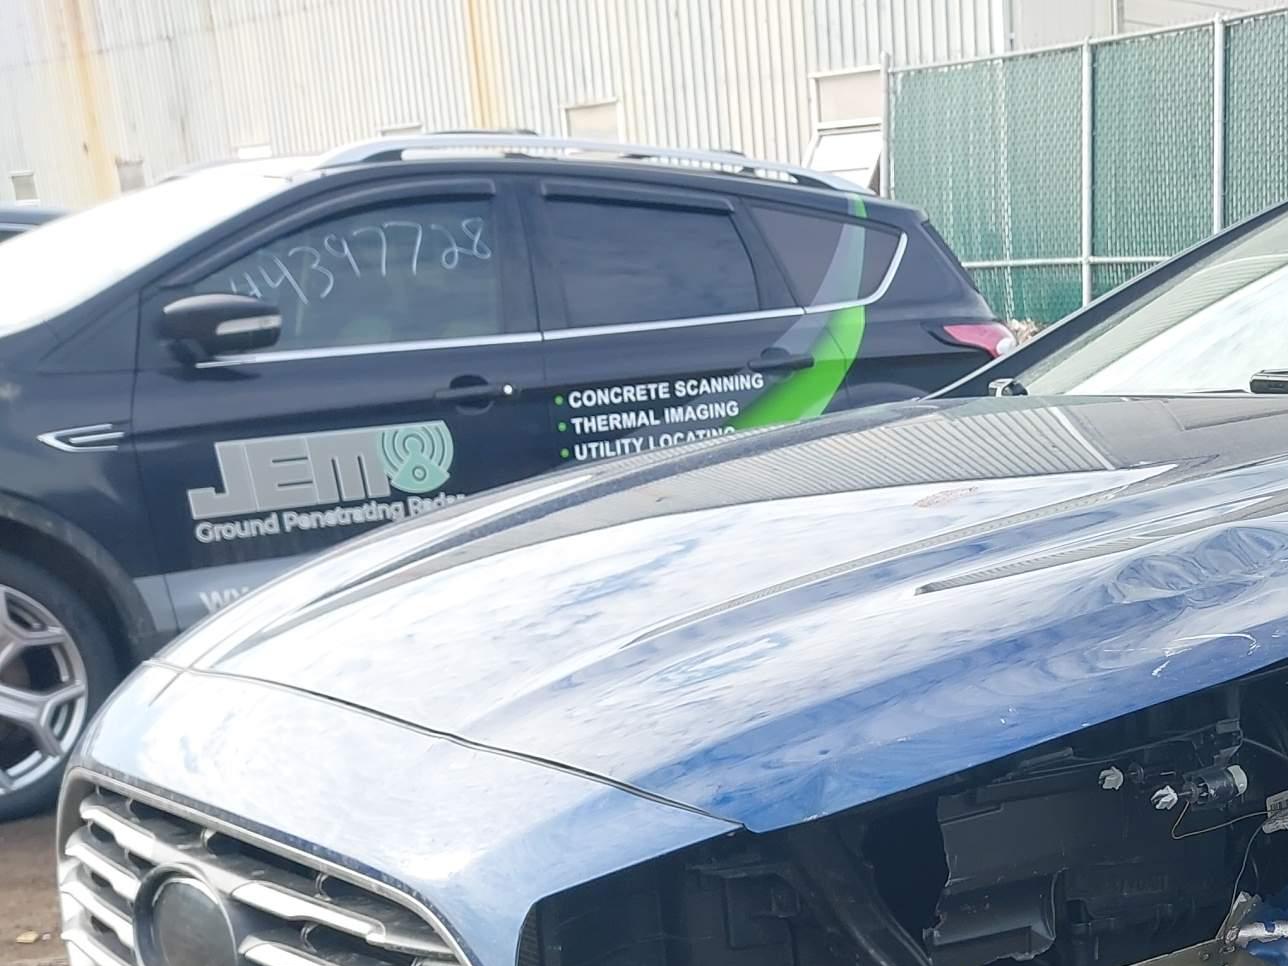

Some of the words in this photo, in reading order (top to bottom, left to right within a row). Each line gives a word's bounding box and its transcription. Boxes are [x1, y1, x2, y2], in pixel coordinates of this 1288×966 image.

[568, 382, 670, 409] CONCRETE
[674, 373, 765, 397] SCANNING
[571, 410, 661, 434] THERMAL
[664, 400, 739, 424] IMAGING
[573, 437, 644, 461] UTILITY
[194, 512, 279, 543] Ground
[282, 501, 402, 533] Penetrating
